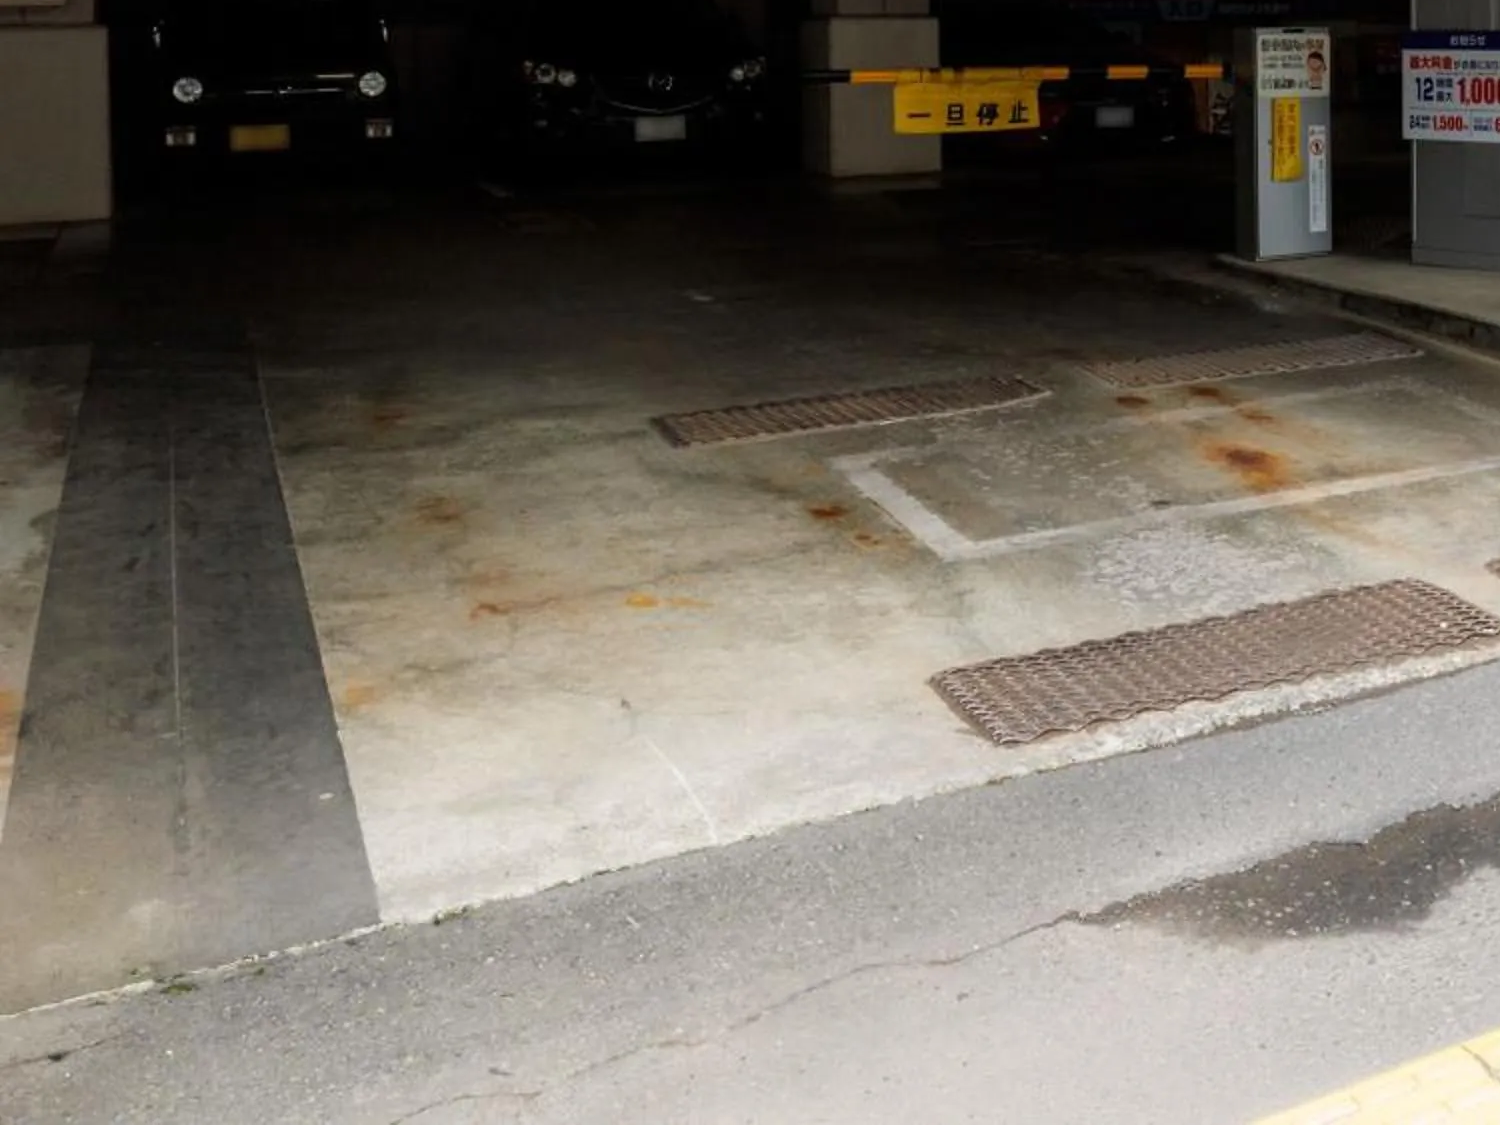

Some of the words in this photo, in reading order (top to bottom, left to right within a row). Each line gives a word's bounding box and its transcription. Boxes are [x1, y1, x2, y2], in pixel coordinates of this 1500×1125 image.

[1415, 77, 1434, 101] 12
[907, 101, 1030, 125] 一旦停止
